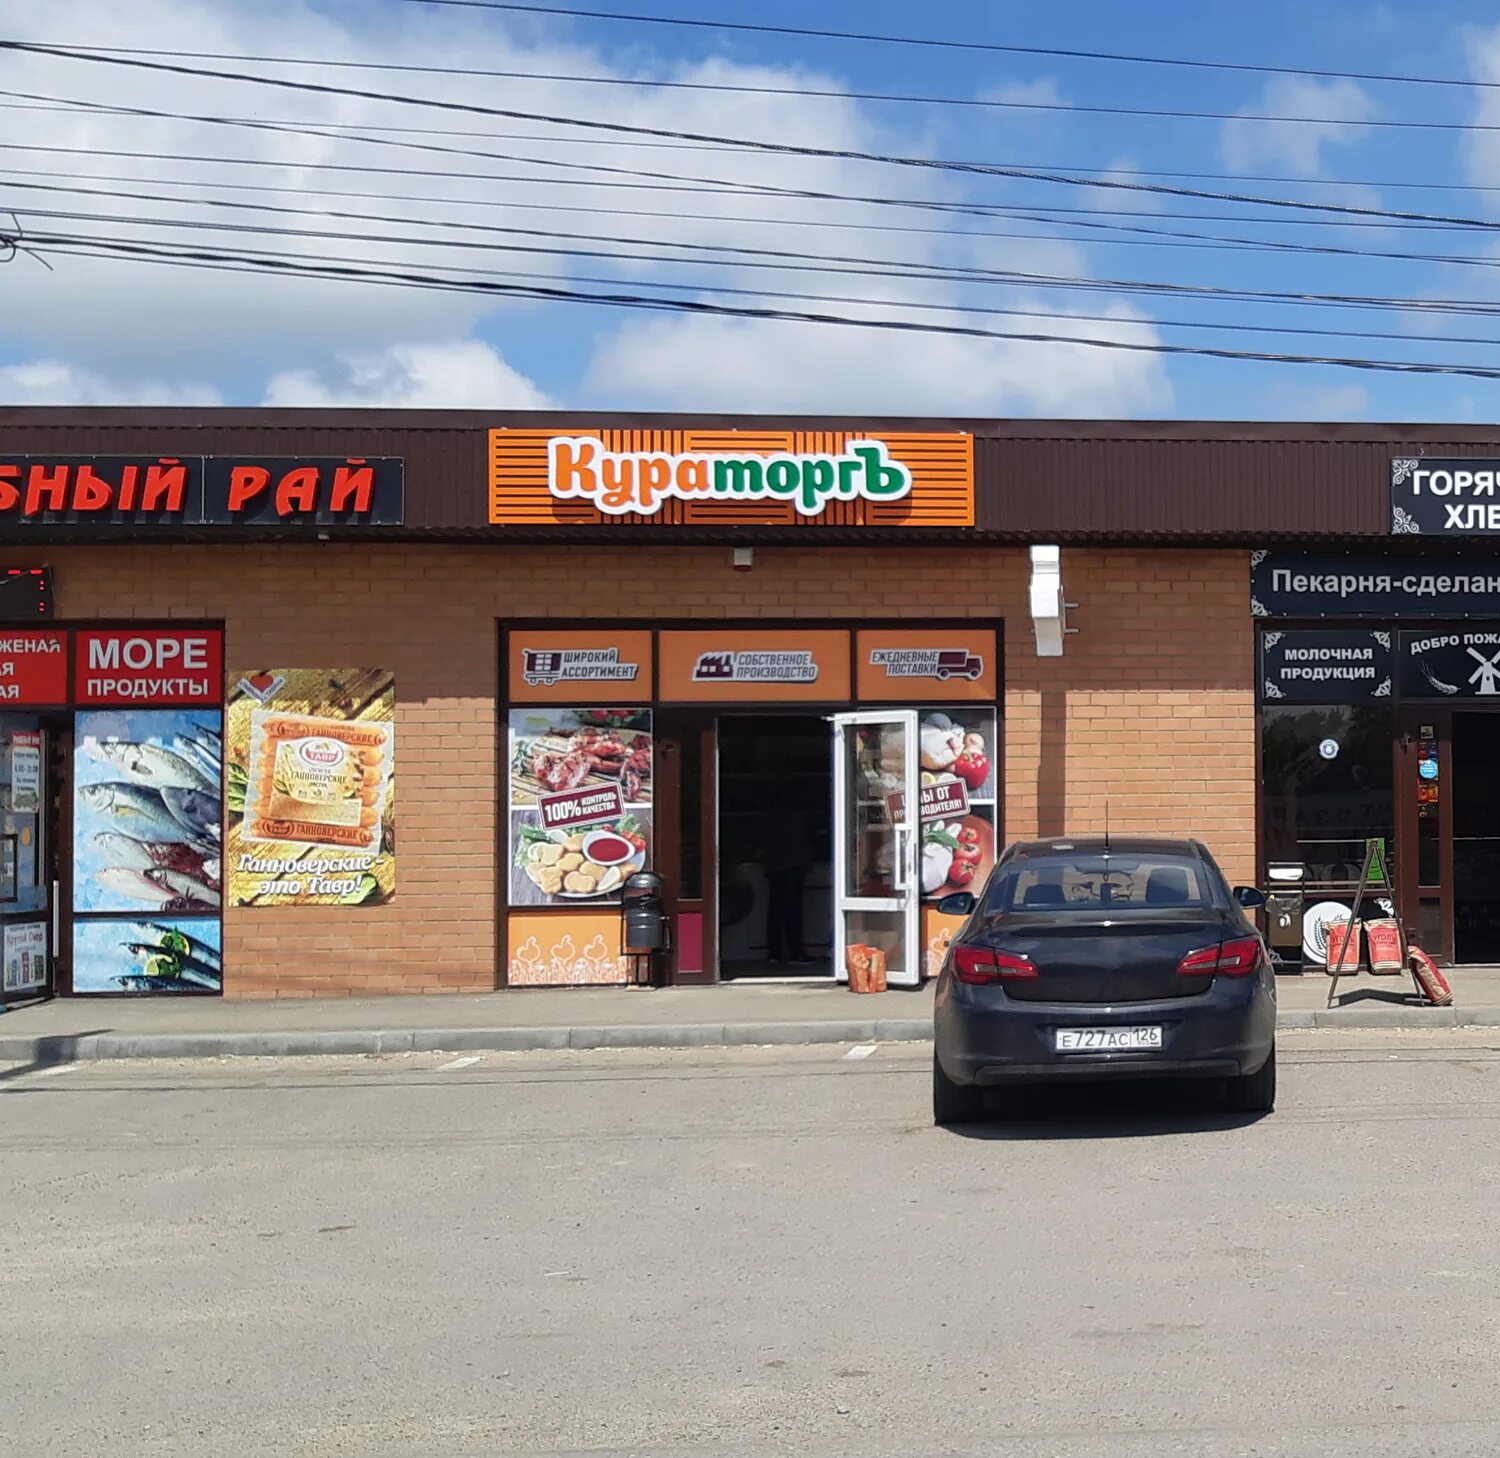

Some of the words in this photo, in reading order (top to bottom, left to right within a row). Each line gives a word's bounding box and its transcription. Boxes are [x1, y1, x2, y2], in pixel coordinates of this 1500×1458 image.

[228, 458, 376, 517] РАЙ
[1410, 634, 1460, 656] ДОБРО
[88, 638, 208, 670] МОРЕ
[563, 649, 617, 663] ШИРОКИЙ
[738, 653, 810, 666] СОБСТВЕННОЕ
[871, 651, 939, 663] ЕЖЕДНЕВНЫЕ
[1284, 647, 1374, 662] МОЛОЧНАЯ
[561, 665, 637, 678] АССОРТИМЕНТ
[736, 666, 816, 679] ПРОИЗВОДСТВО
[887, 663, 937, 675] ПОСТАВКИ
[1280, 665, 1376, 681] ПРОДУКЦИЯ
[86, 678, 208, 698] ПРОДУКТЫ
[581, 791, 617, 807] КОНТРОЛЬ
[936, 785, 950, 800] ОТ
[544, 799, 582, 823] 100%
[582, 801, 616, 816] КАЧЕСТВА
[296, 825, 359, 840] ГАННОВЕРСКИЕ
[237, 853, 372, 878] Ганноверские
[258, 880, 302, 896] это
[306, 874, 364, 899] Тавр!
[1133, 1028, 1158, 1041] 126
